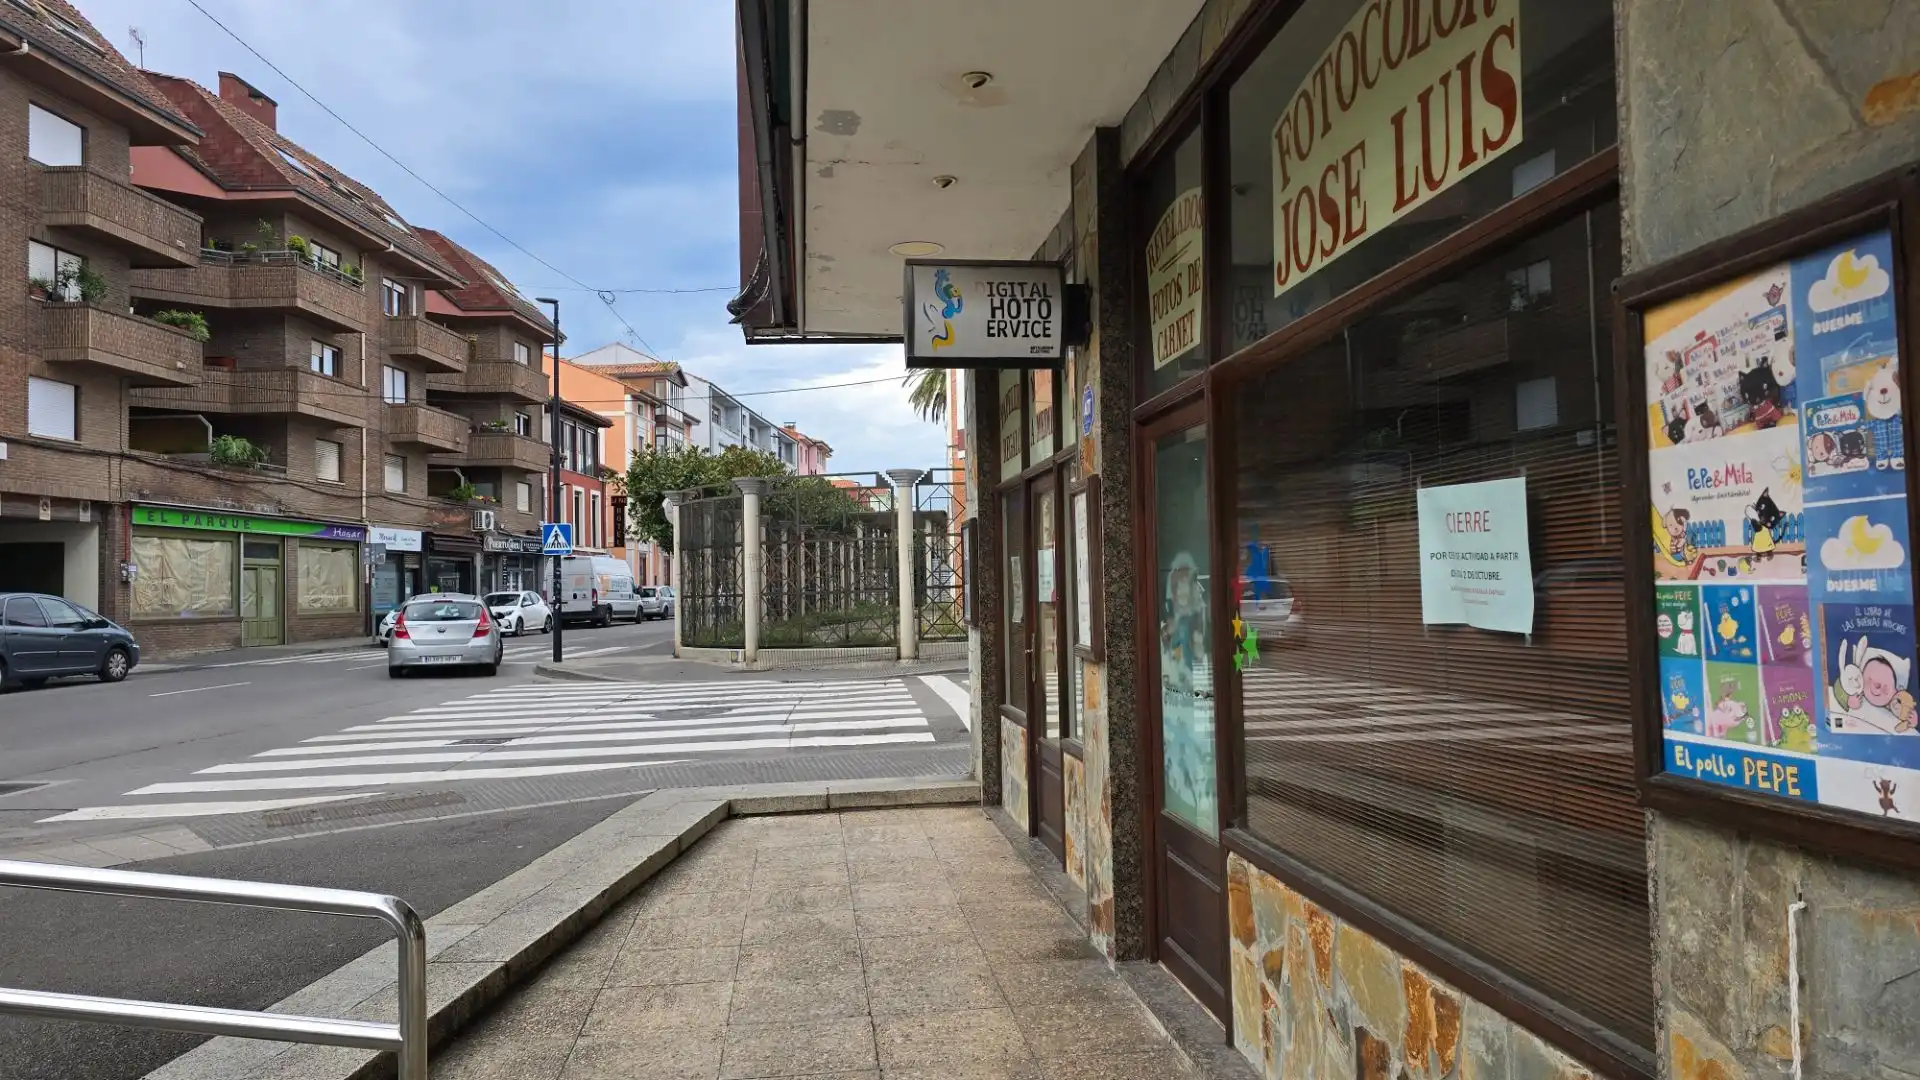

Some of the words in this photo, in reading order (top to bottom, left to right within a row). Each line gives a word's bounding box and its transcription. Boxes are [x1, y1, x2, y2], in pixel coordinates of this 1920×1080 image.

[1276, 136, 1367, 286] JOSE
[1390, 17, 1518, 214] LUIS
[1152, 272, 1183, 325] FOTOS
[1188, 257, 1201, 298] DE
[990, 298, 1052, 320] HOTO
[986, 320, 1052, 338] ERVICE
[1157, 308, 1195, 363] CARNET
[147, 510, 168, 523] EL
[181, 512, 252, 530] PARQUE
[1445, 510, 1492, 534] CIERRE
[1430, 551, 1447, 561] POR
[1496, 551, 1519, 561] PARTIR
[1673, 745, 1693, 770] El
[1696, 752, 1736, 778] pollo
[1742, 756, 1801, 796] PEPE
